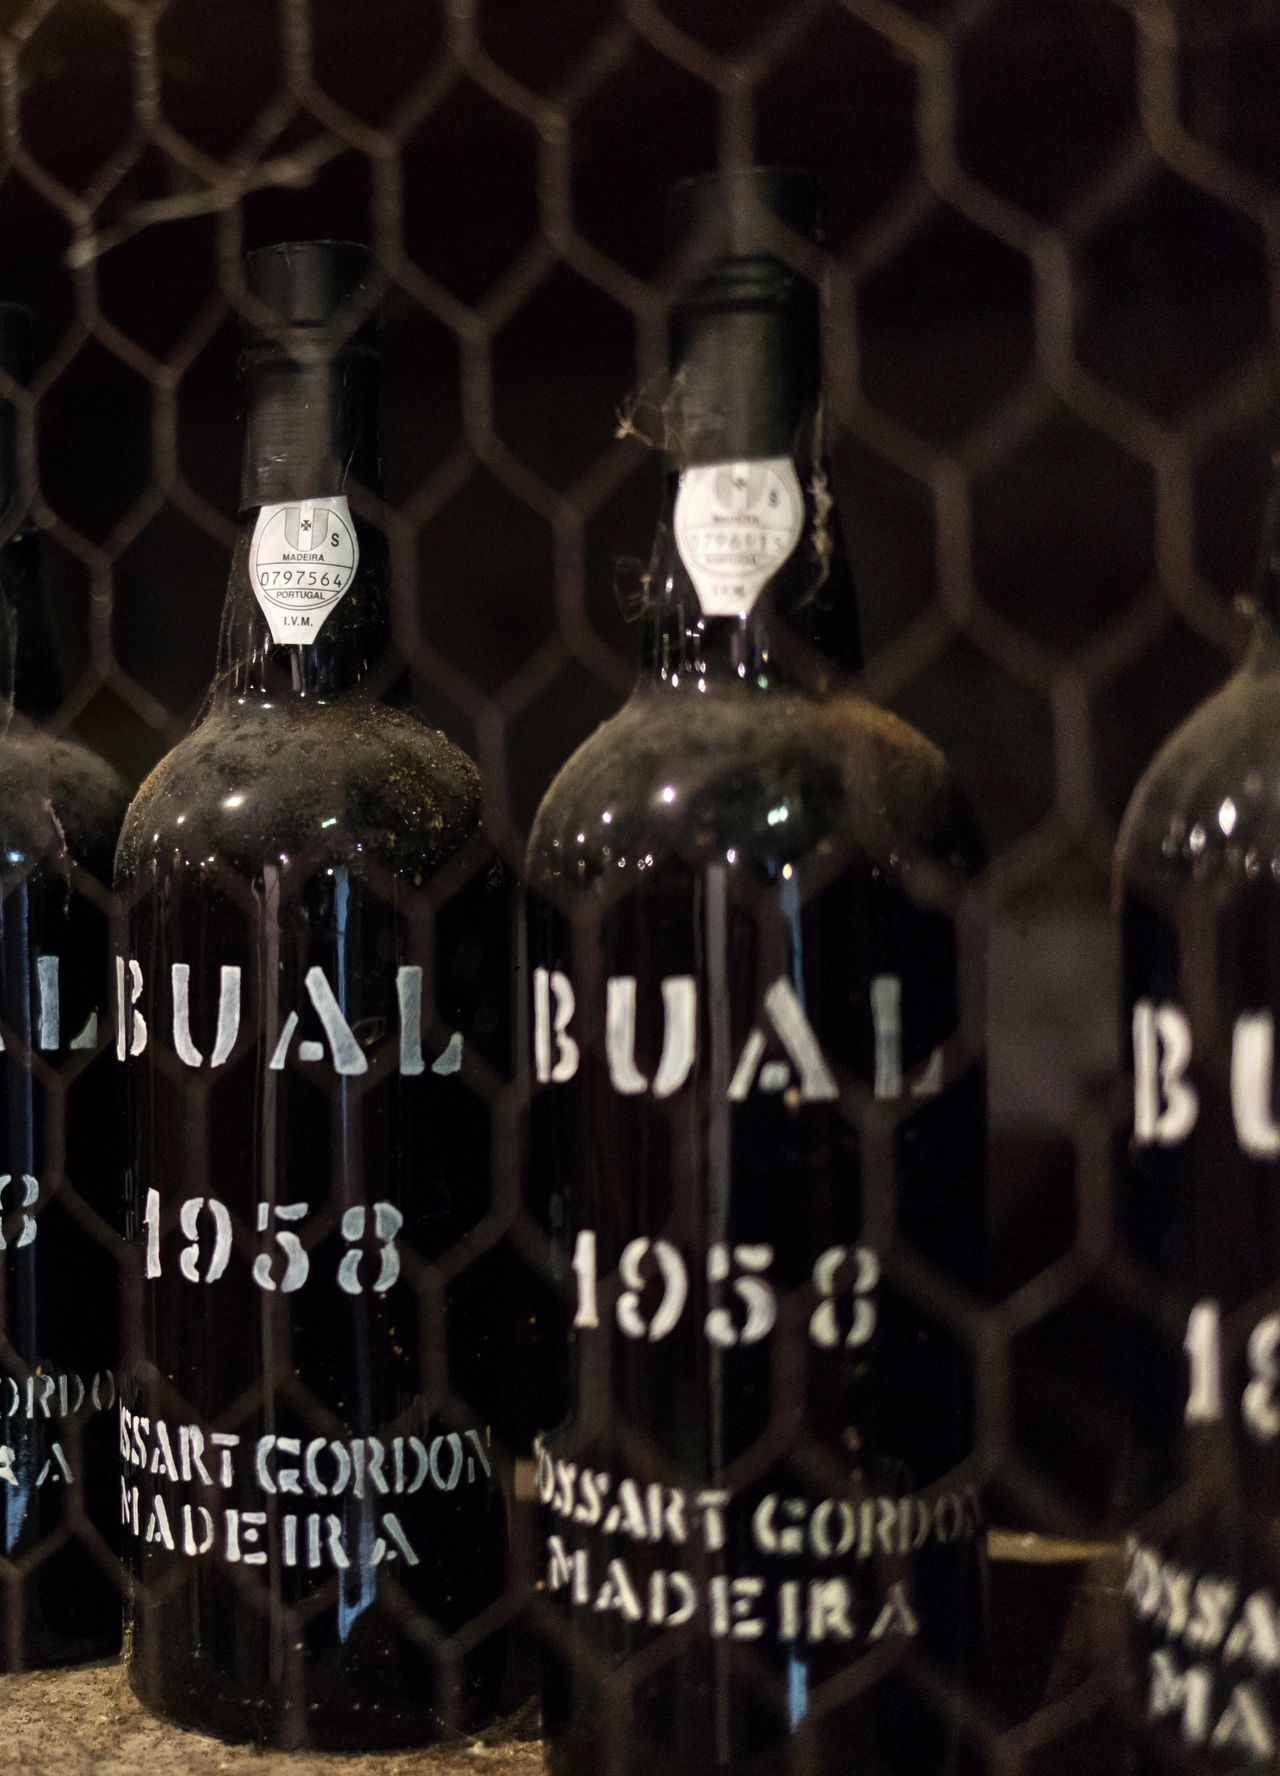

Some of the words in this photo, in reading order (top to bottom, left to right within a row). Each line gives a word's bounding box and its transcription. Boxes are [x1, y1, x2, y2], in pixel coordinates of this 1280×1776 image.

[261, 570, 342, 588] 0797564
[282, 553, 325, 562] MADEIRA
[330, 532, 340, 547] S
[276, 590, 326, 600] PORTUGAL
[283, 616, 314, 627] I.V.M.
[117, 955, 464, 1075] BUAL
[533, 968, 943, 1100] BUAL
[144, 1187, 403, 1294] 1958
[572, 1230, 880, 1347] 1958
[120, 1474, 419, 1568] MADEIRA
[547, 1534, 919, 1644] MADEIRA
